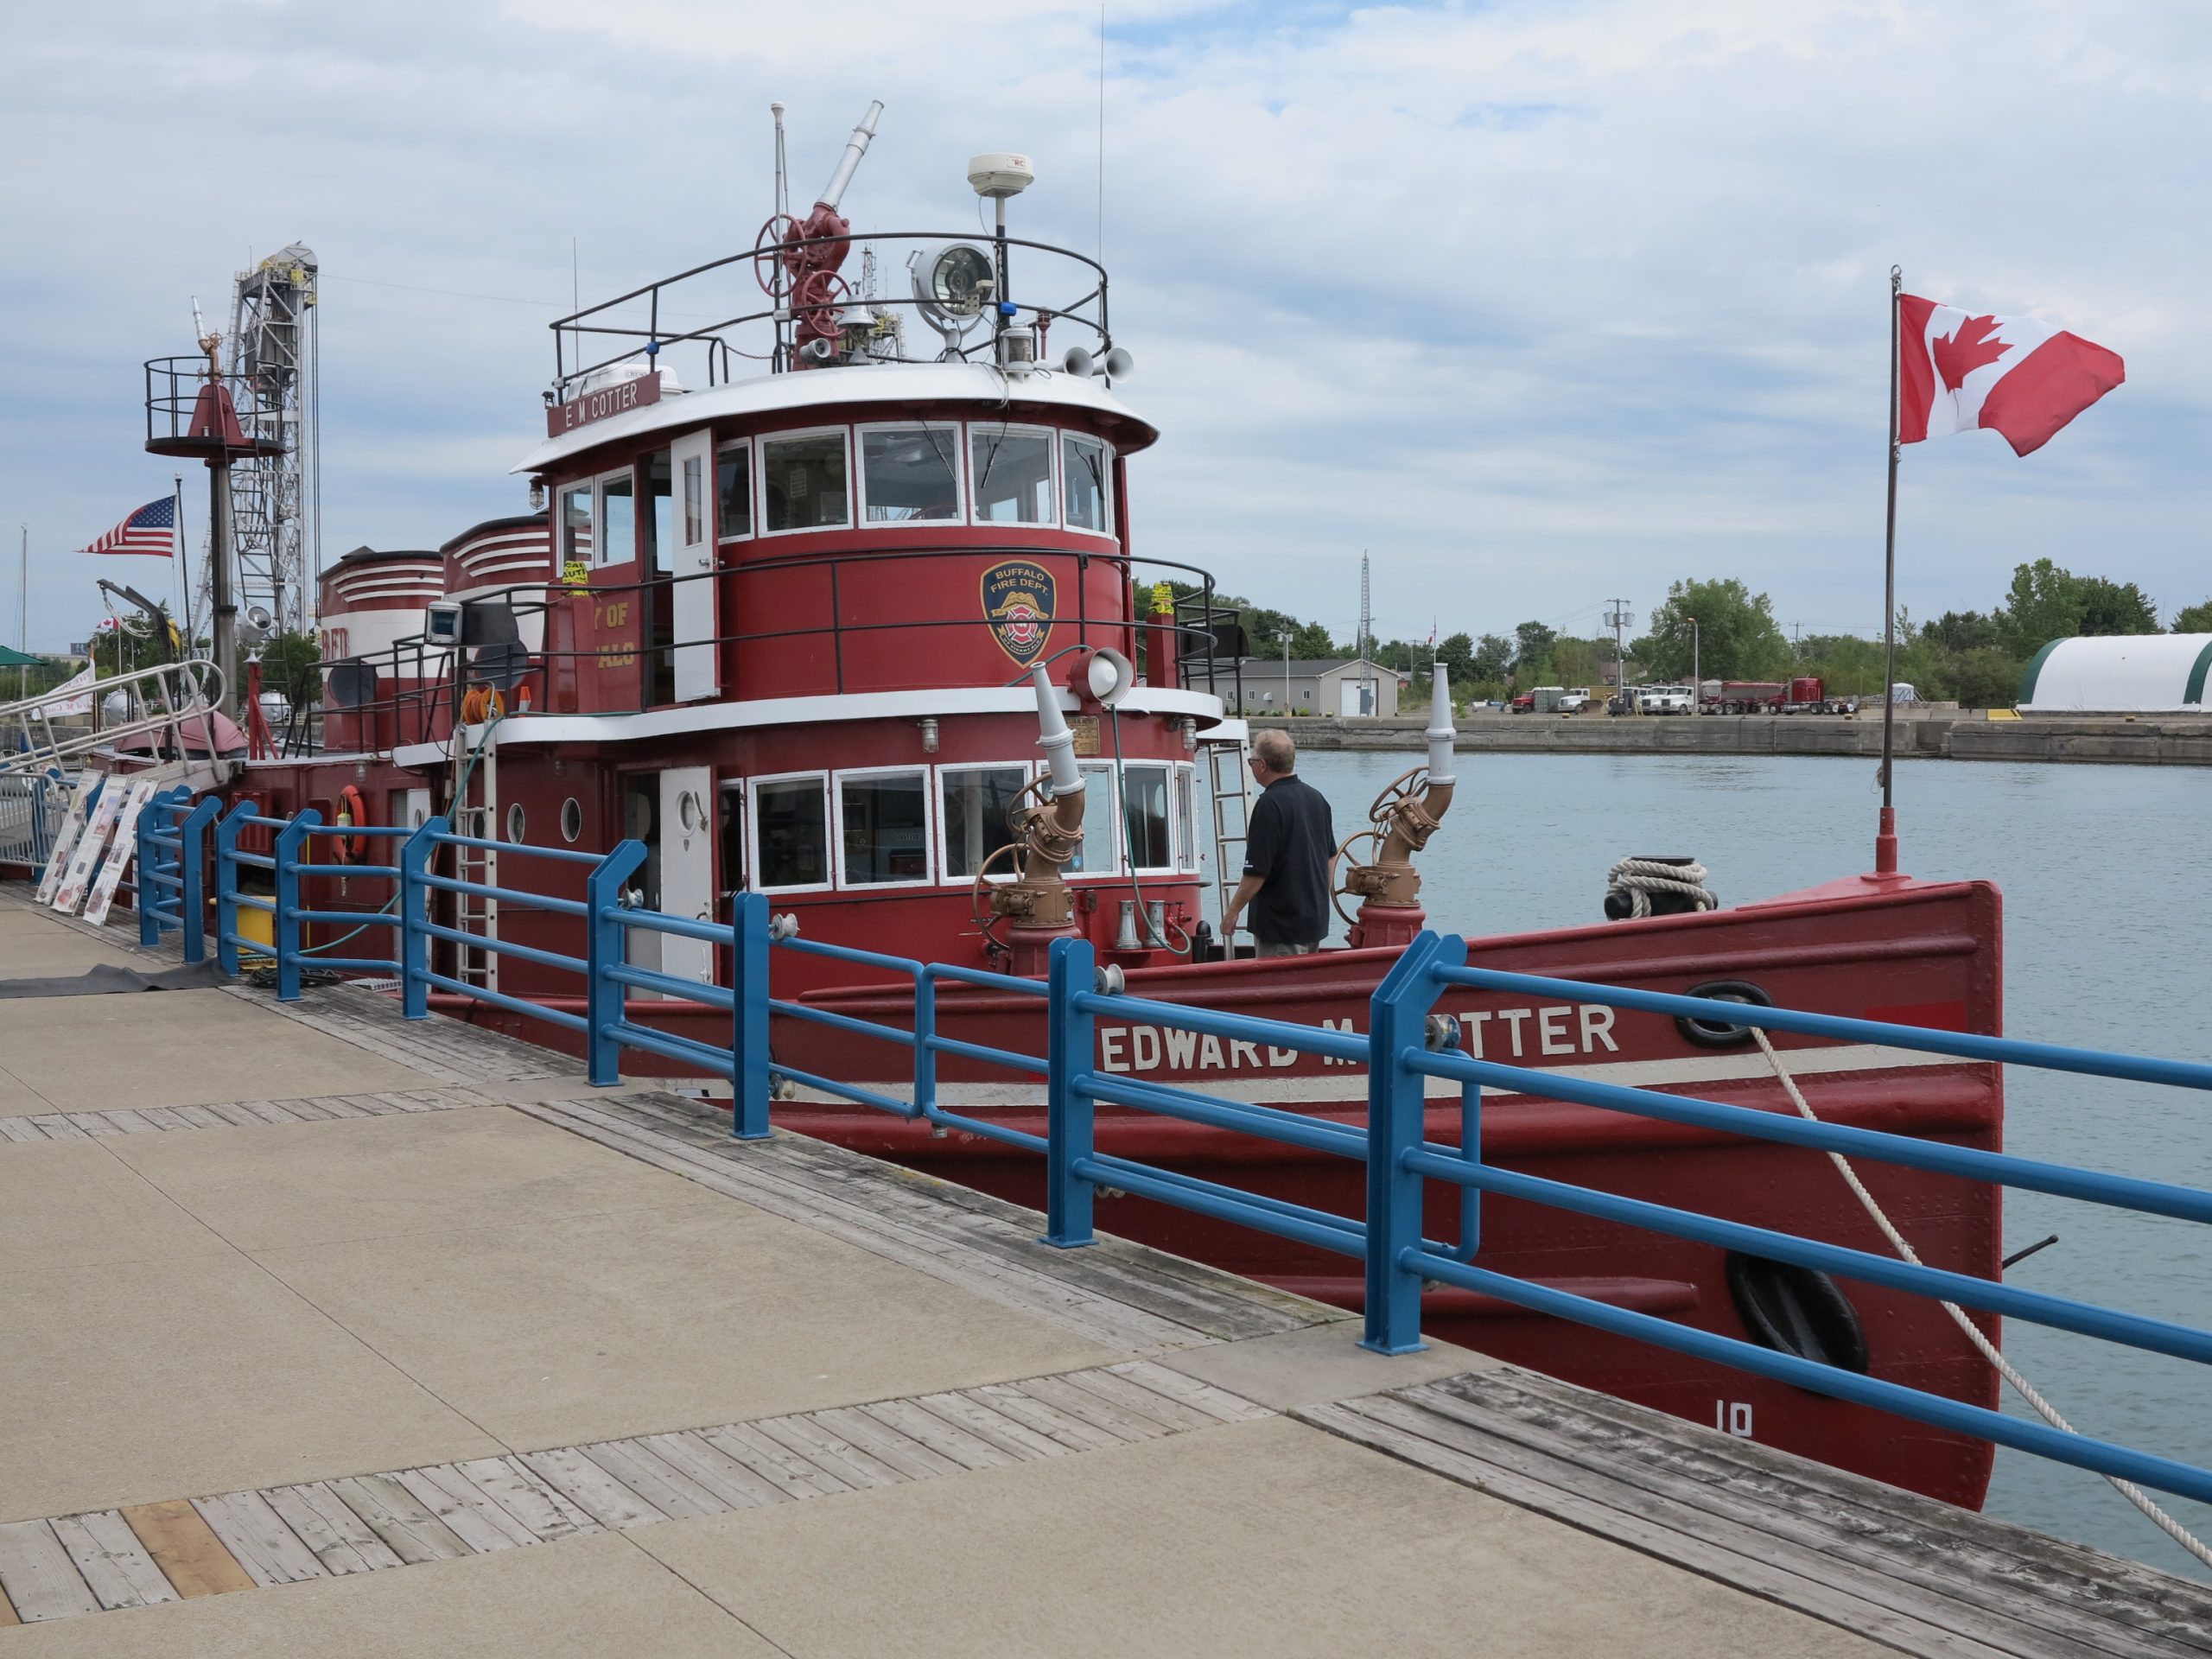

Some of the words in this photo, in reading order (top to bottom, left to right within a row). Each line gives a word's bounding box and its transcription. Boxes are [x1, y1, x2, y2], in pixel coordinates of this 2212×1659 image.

[566, 405, 572, 427] E
[579, 401, 585, 423] M
[592, 382, 638, 417] COTTER
[990, 578, 1016, 593] FIRE
[1020, 578, 1049, 596] DEPT.
[995, 569, 1045, 582] BUFFALO
[607, 602, 629, 627] OF
[1101, 1026, 1298, 1071] EDWARD
[1459, 1004, 1618, 1058] TTER
[1717, 1400, 1752, 1437] 10
